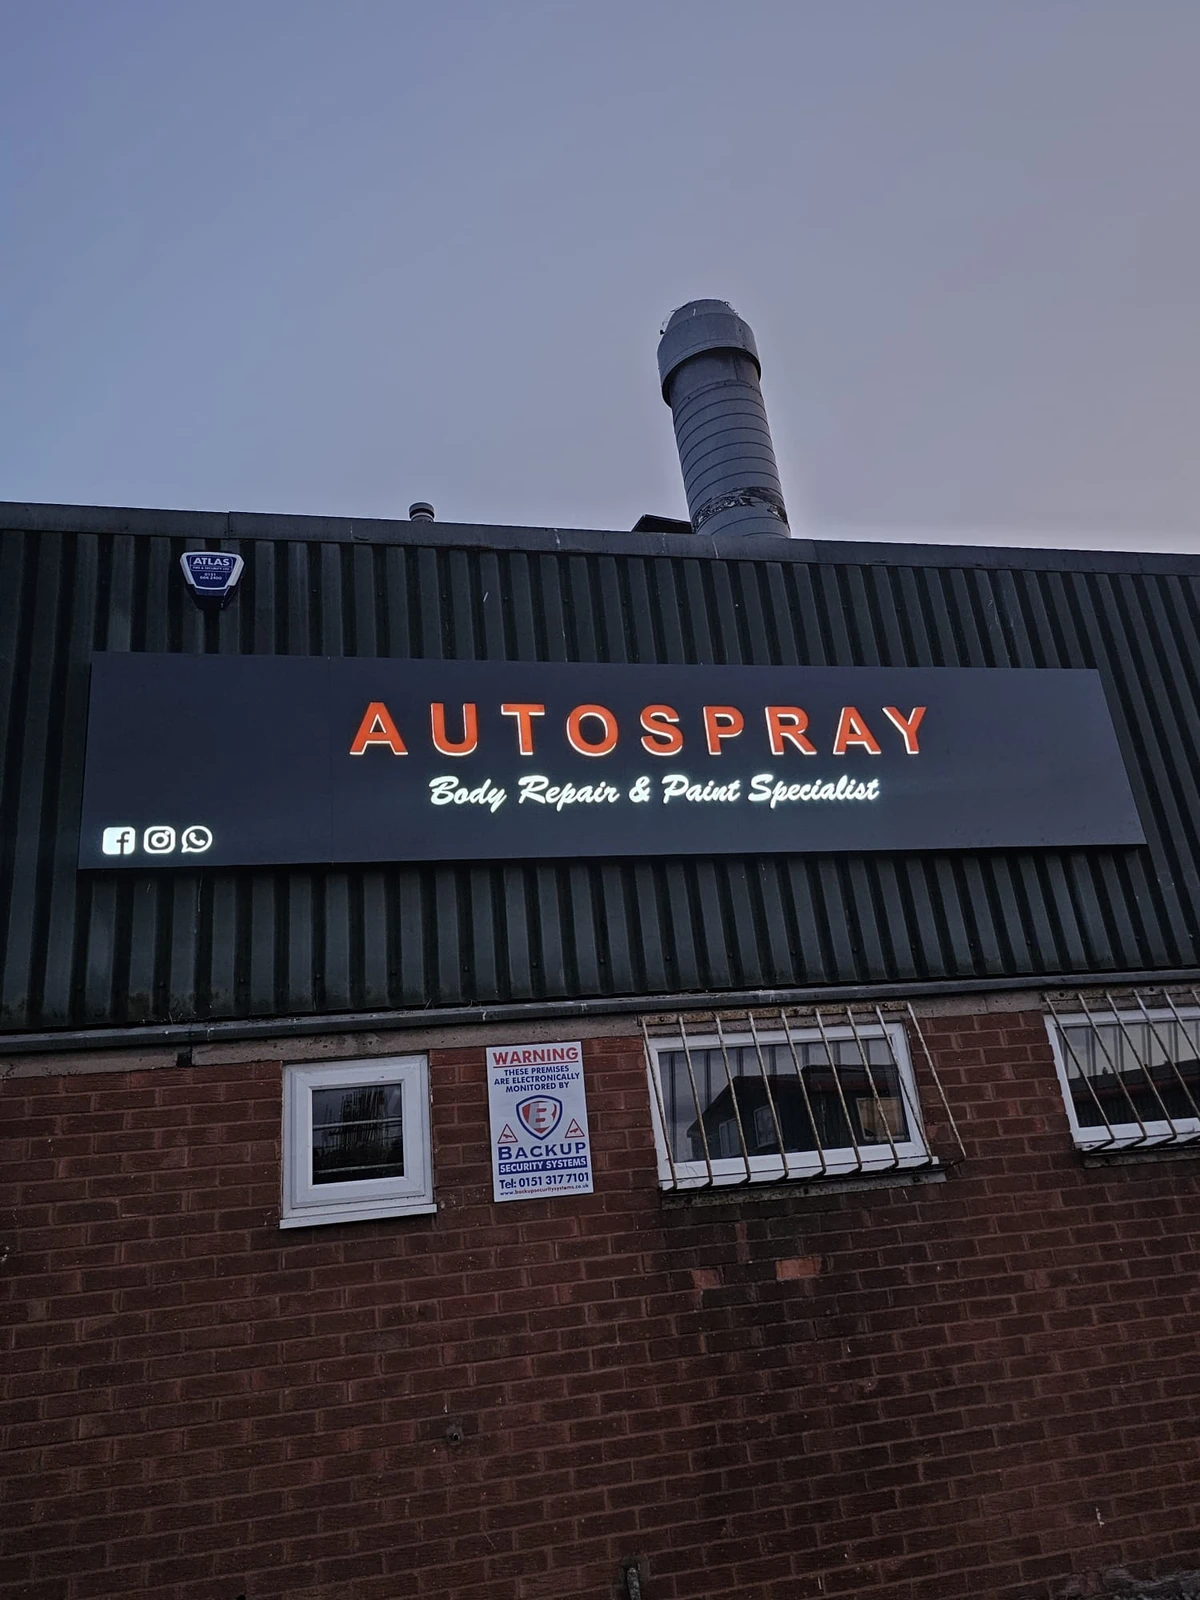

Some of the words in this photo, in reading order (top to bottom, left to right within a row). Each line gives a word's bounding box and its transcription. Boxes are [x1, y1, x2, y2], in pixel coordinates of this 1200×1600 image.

[193, 557, 230, 566] ATLAS
[349, 702, 926, 757] AUTOSPRAY
[428, 775, 508, 814] Body
[517, 774, 620, 812] Repair
[628, 775, 651, 803] &
[661, 773, 741, 804] Paint
[747, 773, 881, 809] Specialist
[492, 1047, 579, 1065] WARNING
[504, 1068, 529, 1076] THESE
[531, 1065, 569, 1074] PREMISES
[512, 1072, 580, 1084] ELECTRONICALLY
[505, 1083, 556, 1093] MONITORED
[558, 1081, 569, 1089] BY
[498, 1142, 586, 1160] BACKUP
[500, 1161, 543, 1173] SECURITY
[546, 1157, 586, 1169] SYSTEMS
[499, 1178, 517, 1189] Tel:
[518, 1176, 542, 1188] 0151
[545, 1174, 564, 1185] 317
[566, 1172, 589, 1184] 7101
[500, 1184, 589, 1196] www.backupsecuritysystems.co.uk
